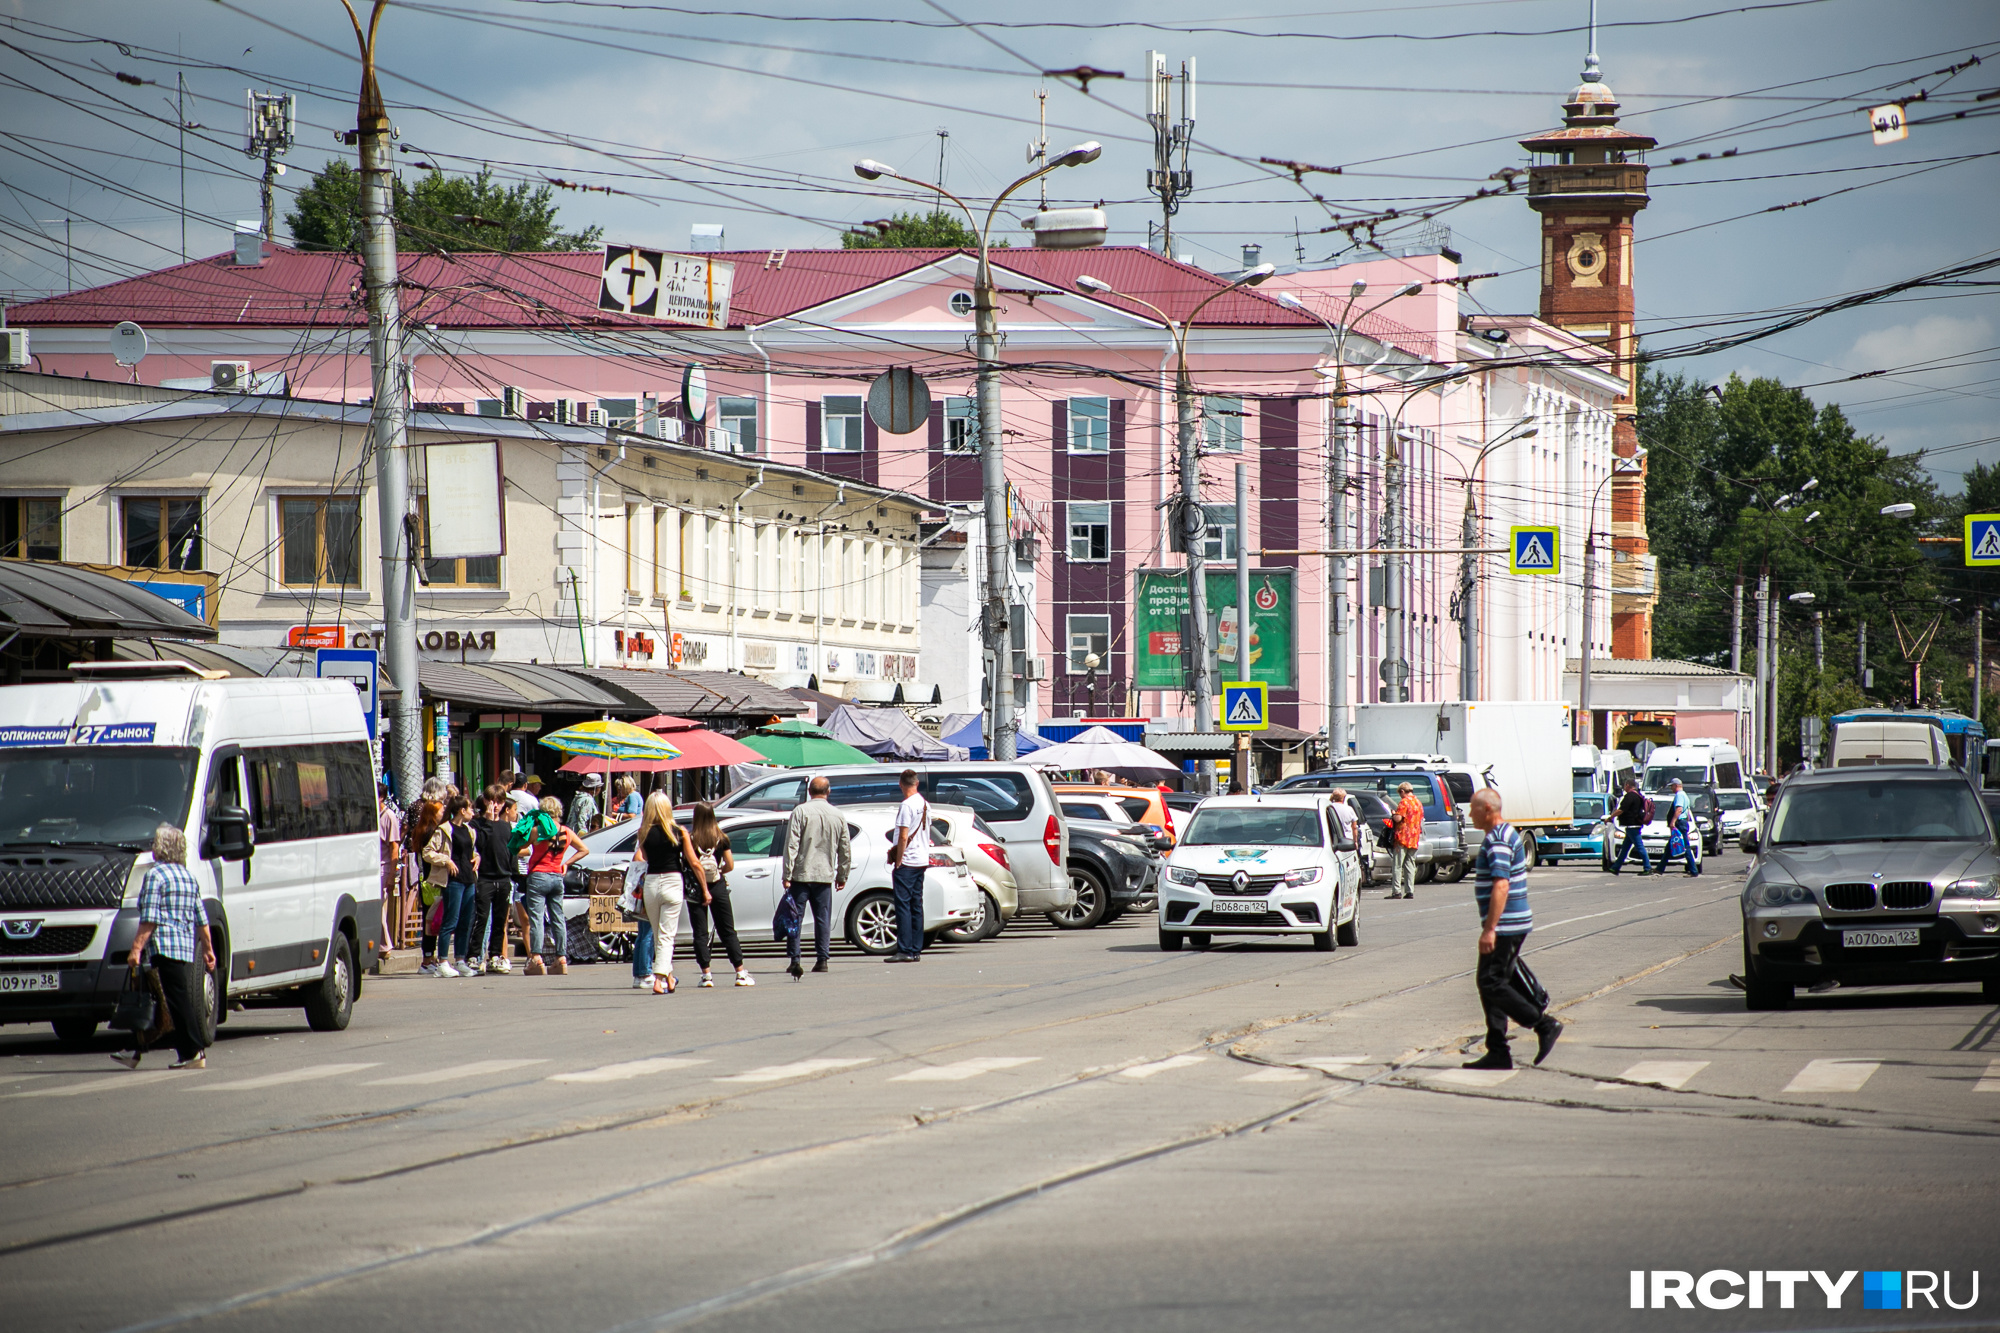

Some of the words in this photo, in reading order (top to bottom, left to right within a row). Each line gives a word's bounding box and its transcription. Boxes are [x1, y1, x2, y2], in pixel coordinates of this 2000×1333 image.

[669, 294, 721, 312] ЦЕНТРАЛЬНЫЙ
[667, 308, 719, 321] РЫНОК
[1149, 585, 1188, 595] Достав
[1149, 595, 1207, 607] продук
[1164, 607, 1176, 616] 30
[352, 631, 496, 651] СТОВАЯ
[75, 726, 106, 744] 27
[1251, 902, 1265, 910] 124
[1847, 933, 1896, 945] А070ОА
[1898, 931, 1916, 941] 123
[41, 974, 55, 985] 38
